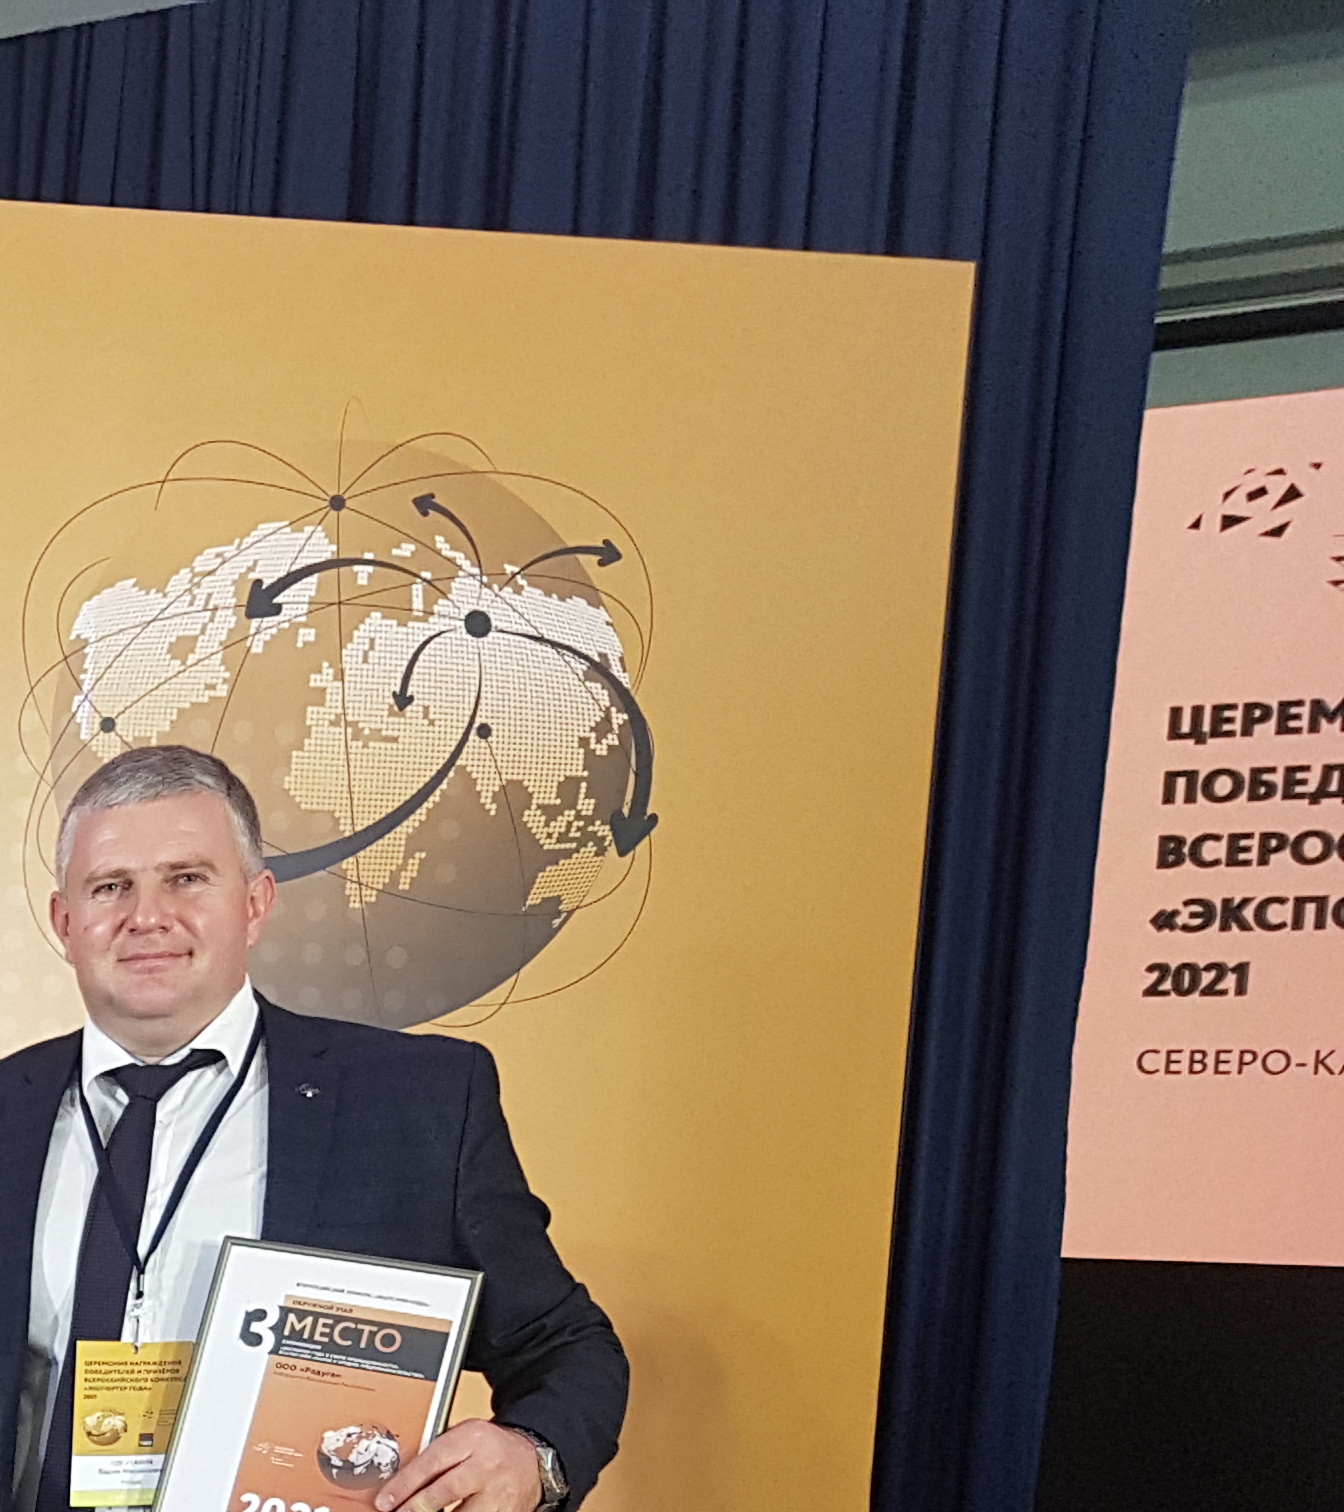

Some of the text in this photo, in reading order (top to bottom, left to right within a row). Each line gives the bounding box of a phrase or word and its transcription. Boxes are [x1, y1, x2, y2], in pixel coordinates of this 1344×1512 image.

[1155, 829, 1344, 870] ВСЕРО
[1141, 960, 1251, 998] 2021
[1135, 1048, 1344, 1077] СЕВЕРО-К
[282, 1312, 403, 1353] МЕСТО
[275, 1362, 297, 1372] ООО
